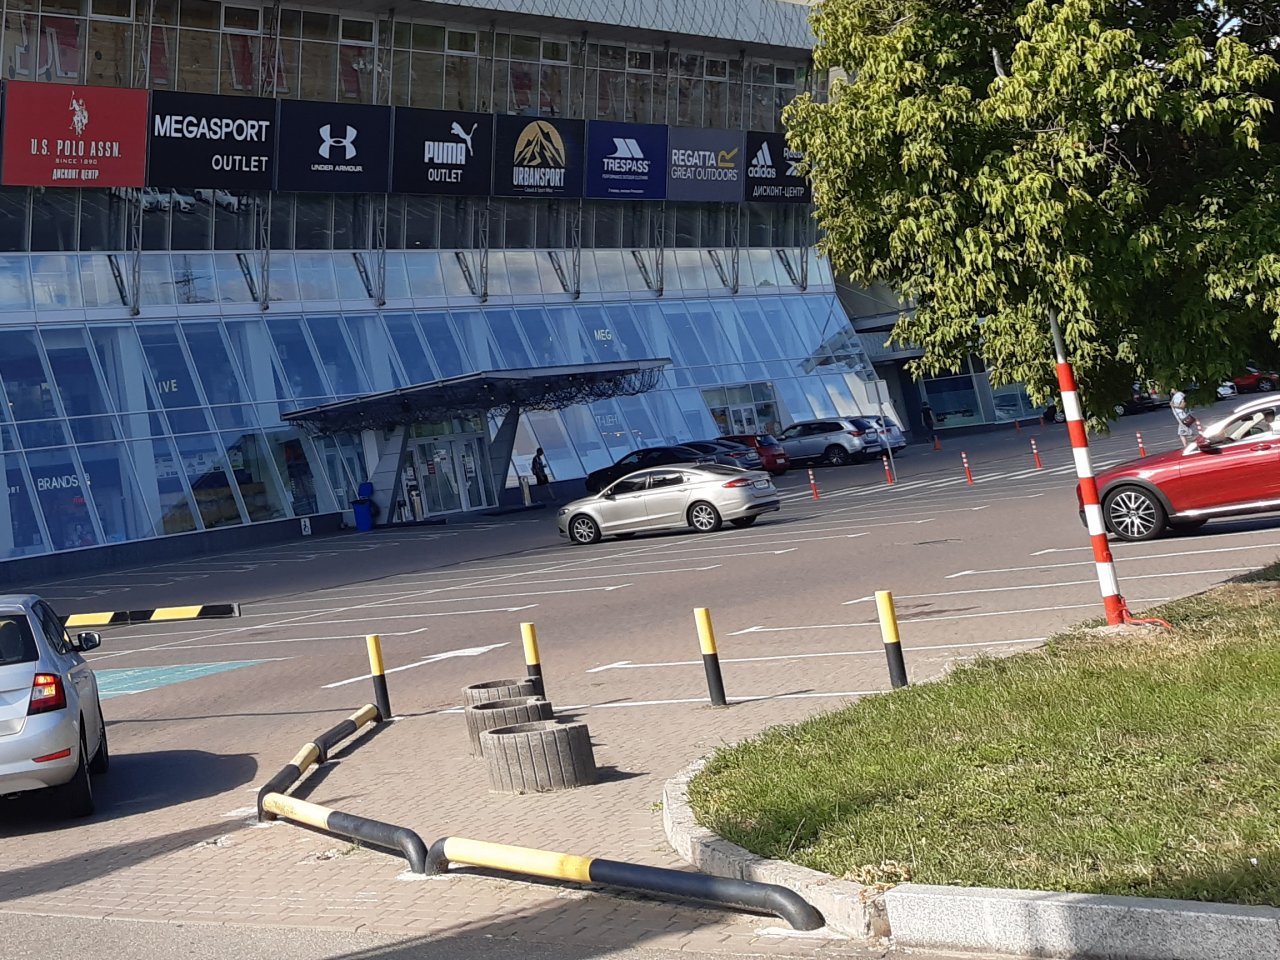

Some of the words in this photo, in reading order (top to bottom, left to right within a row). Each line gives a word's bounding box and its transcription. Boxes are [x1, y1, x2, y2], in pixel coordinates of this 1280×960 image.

[155, 114, 270, 142] MEGASPORT
[31, 139, 50, 156] U.S.
[57, 140, 84, 156] POLO
[90, 141, 121, 157] ASSN.
[425, 141, 466, 165] PUMA
[212, 155, 268, 172] OUTLET
[602, 158, 649, 173] TRESPASS
[671, 149, 716, 167] REGATTA
[428, 169, 463, 183] OUTLET
[513, 167, 565, 187] URBANSPORT
[671, 166, 695, 179] GREAT
[696, 168, 738, 181] OUTDOORS
[748, 165, 776, 178] adidas
[753, 185, 805, 197] ДИСКОНТ-ЦЕНТР
